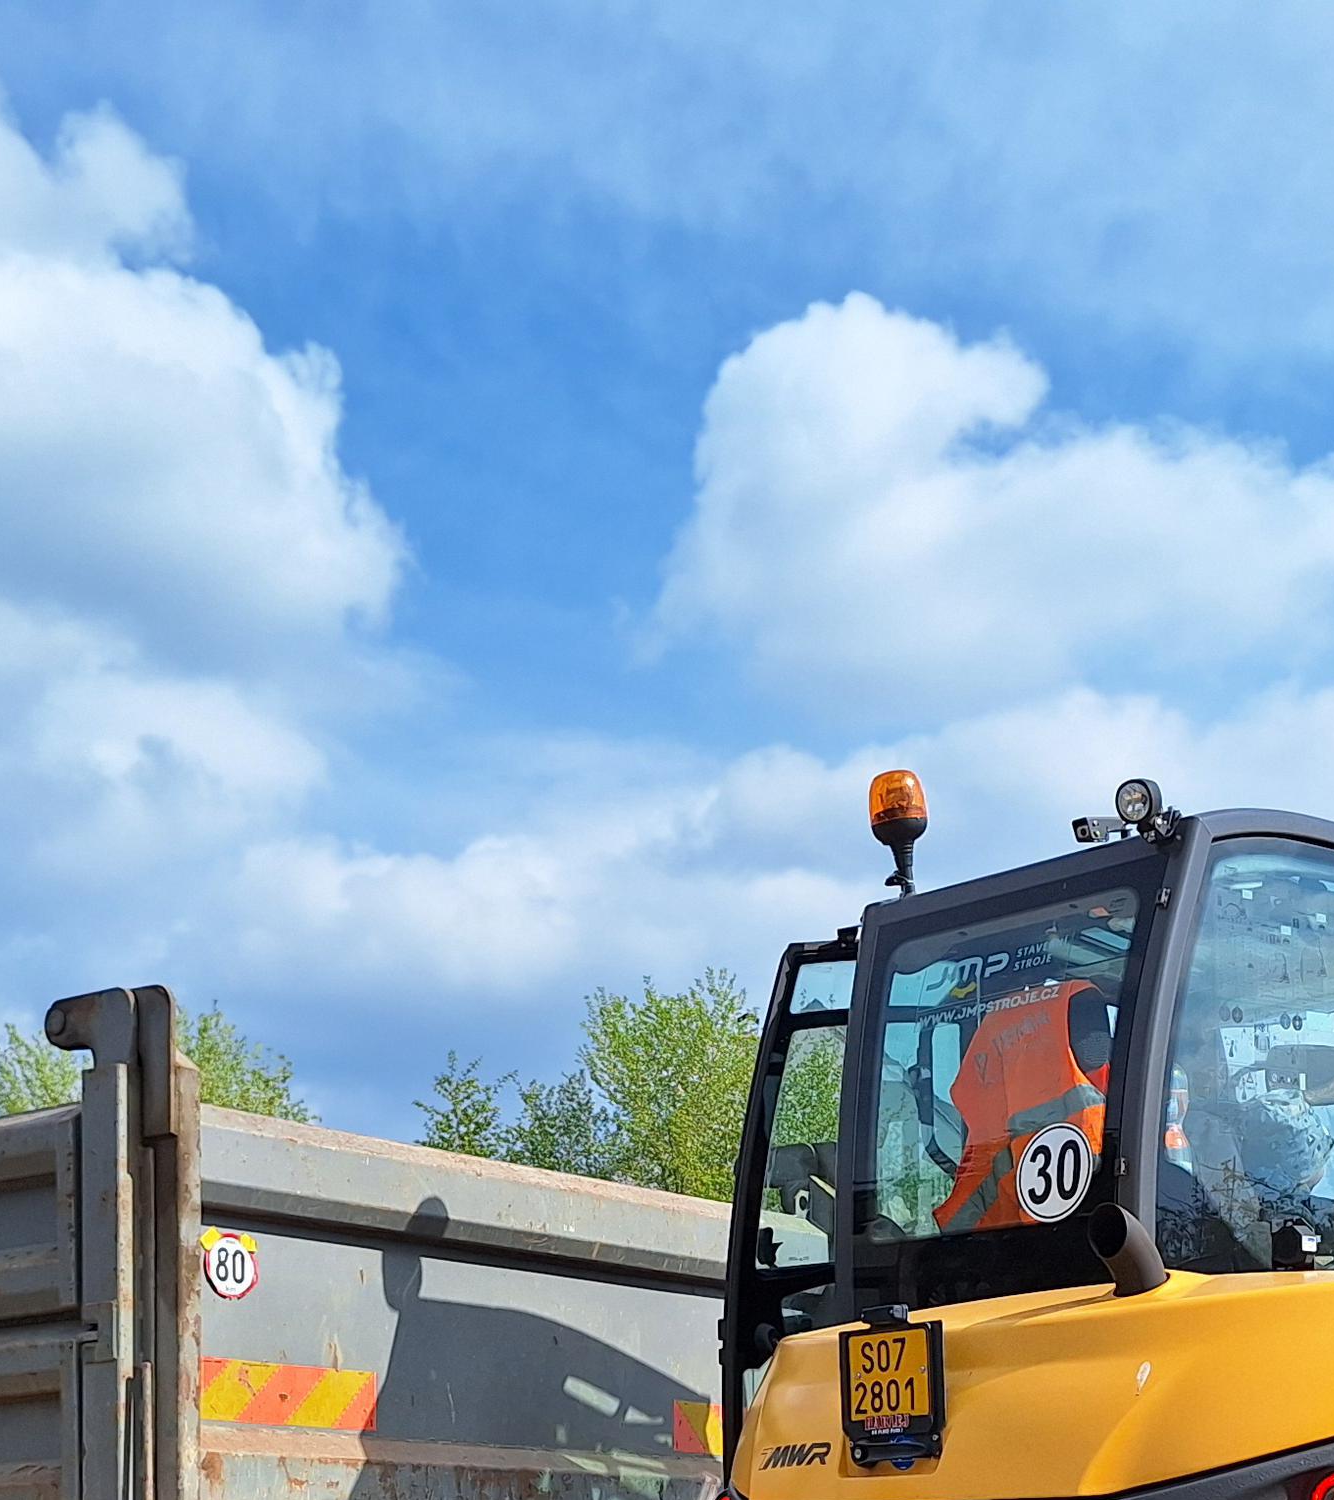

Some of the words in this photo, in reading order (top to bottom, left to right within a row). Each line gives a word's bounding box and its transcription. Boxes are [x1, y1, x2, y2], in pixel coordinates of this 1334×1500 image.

[1013, 954, 1052, 971] STROJE
[919, 986, 1060, 1025] WWW.JMPSTROJE.CZ
[1028, 1139, 1081, 1205] 30
[216, 1247, 245, 1284] 80
[861, 1337, 906, 1374] S07
[855, 1377, 915, 1414] 2801
